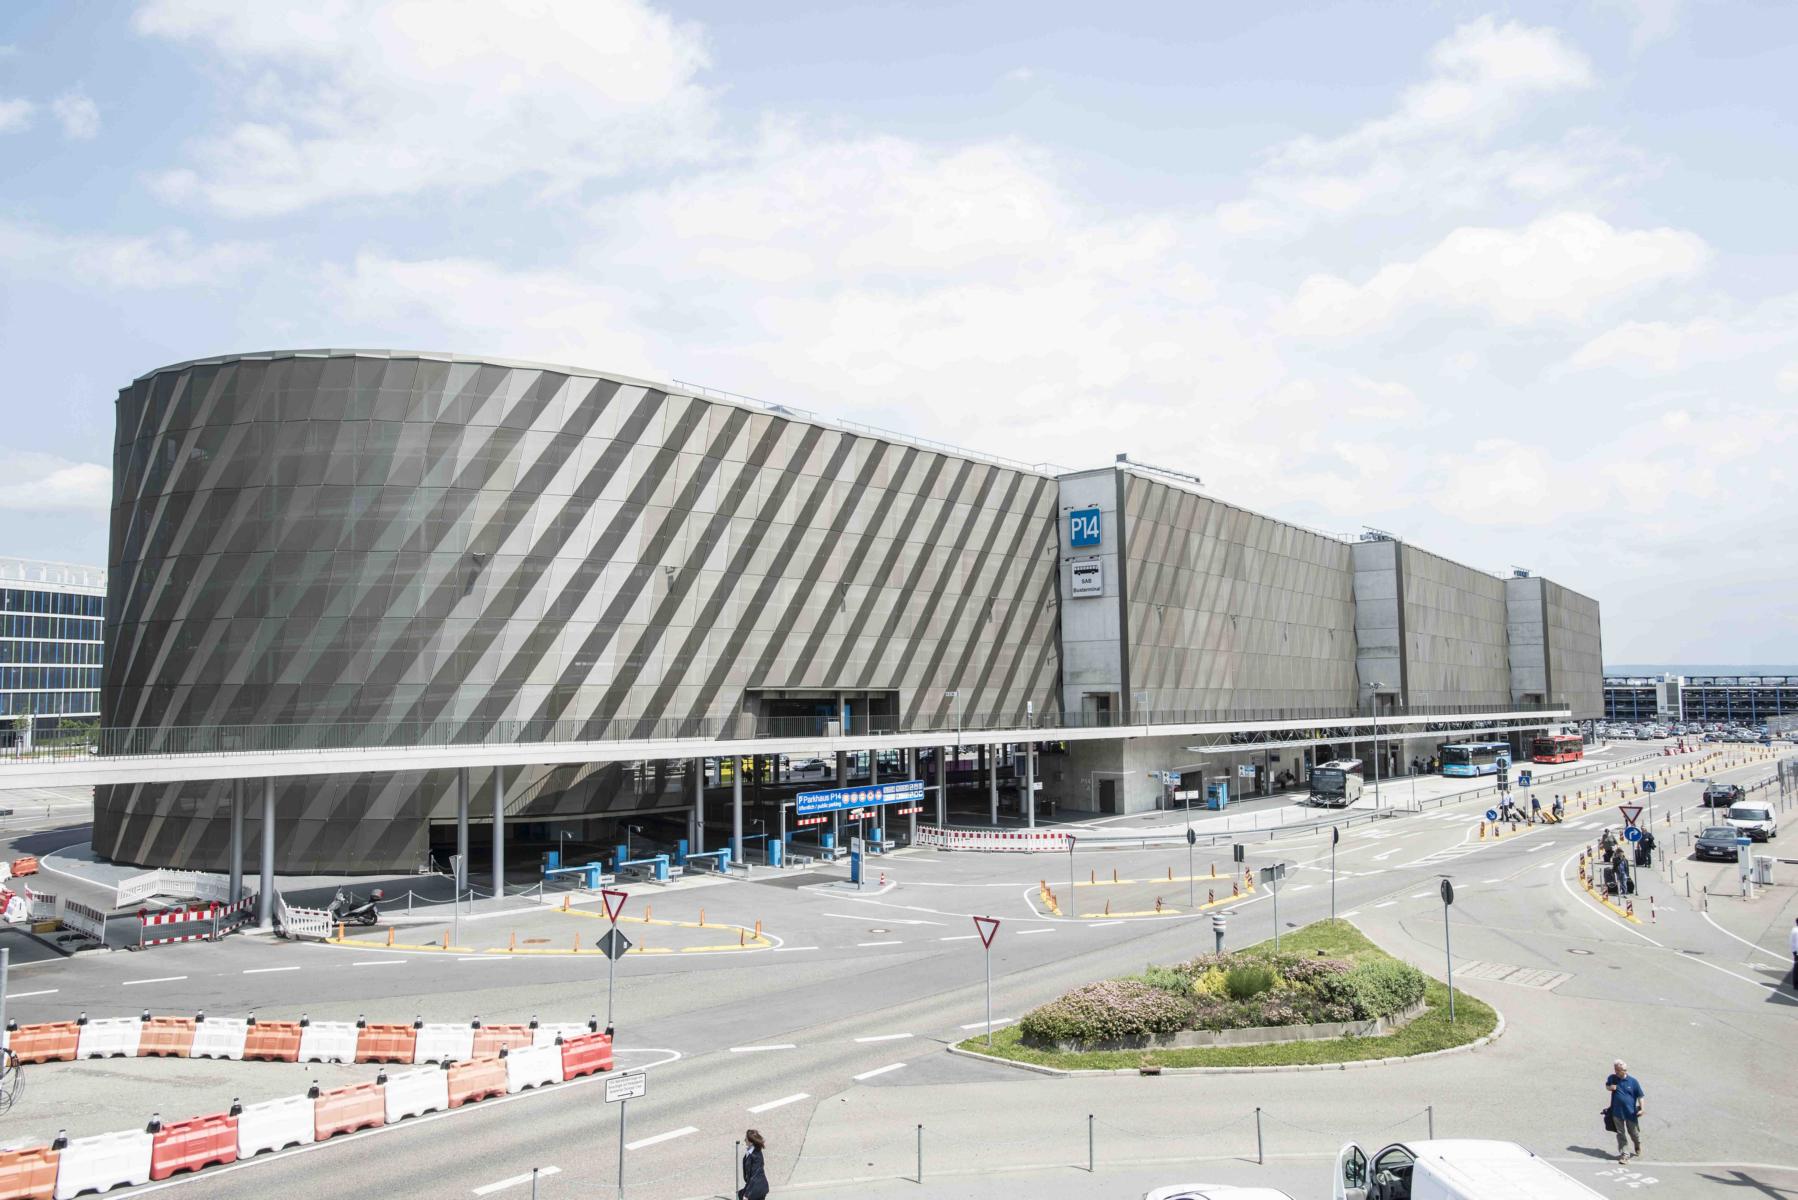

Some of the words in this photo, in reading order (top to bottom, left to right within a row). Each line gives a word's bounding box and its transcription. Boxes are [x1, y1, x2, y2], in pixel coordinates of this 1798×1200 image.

[1072, 516, 1099, 540] P14
[803, 795, 829, 804] Parkhaus
[830, 793, 841, 801] P14
[1595, 1171, 1642, 1188] P14
[1611, 1168, 1659, 1184] SAB
